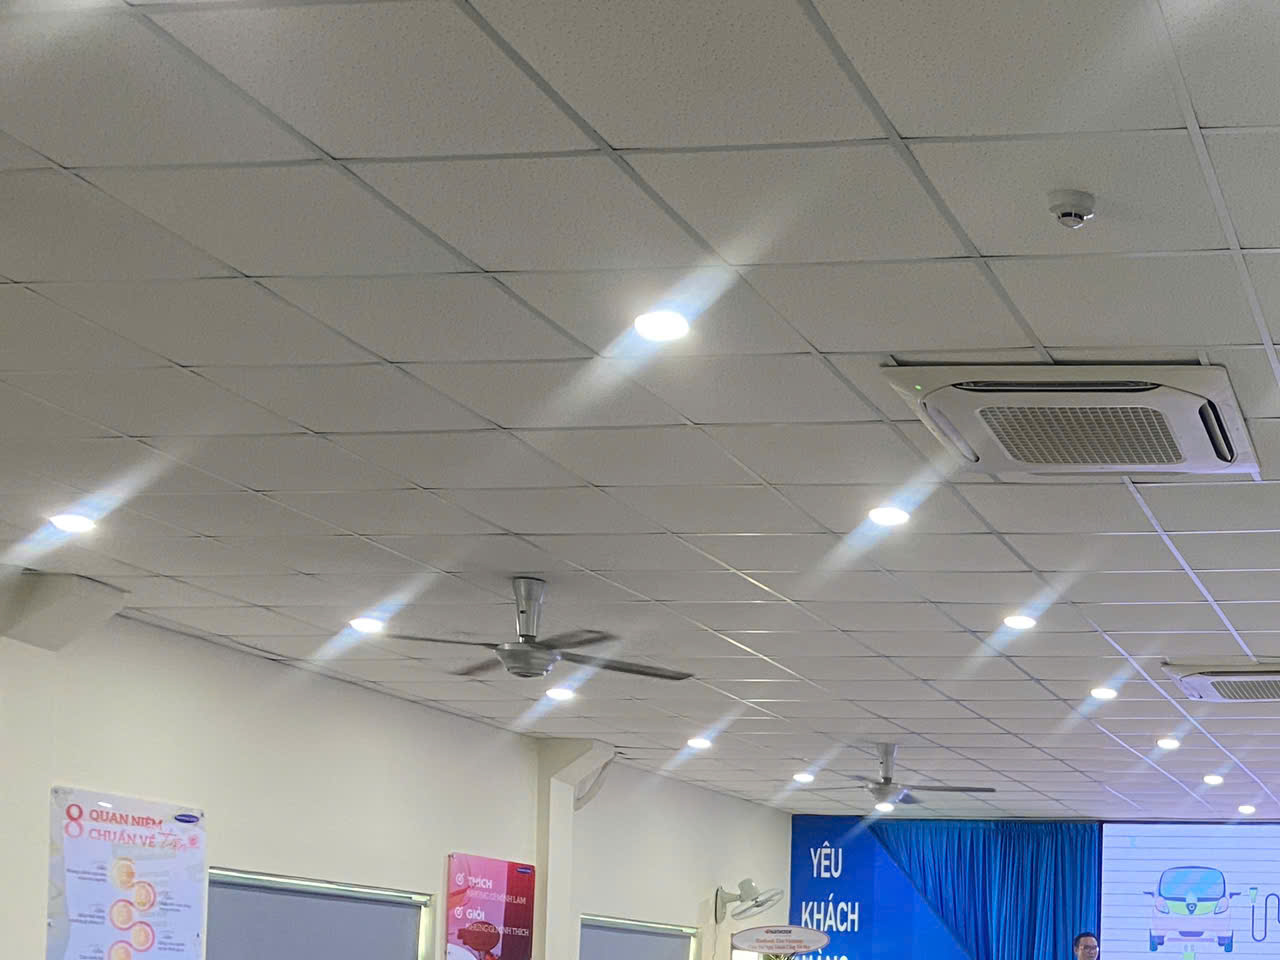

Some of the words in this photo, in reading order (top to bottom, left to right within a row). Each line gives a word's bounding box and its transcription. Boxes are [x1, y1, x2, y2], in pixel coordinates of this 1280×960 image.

[65, 804, 83, 838] 8
[89, 809, 129, 825] QUAN
[810, 840, 842, 878] YÊU
[801, 893, 859, 932] KHÁCH
